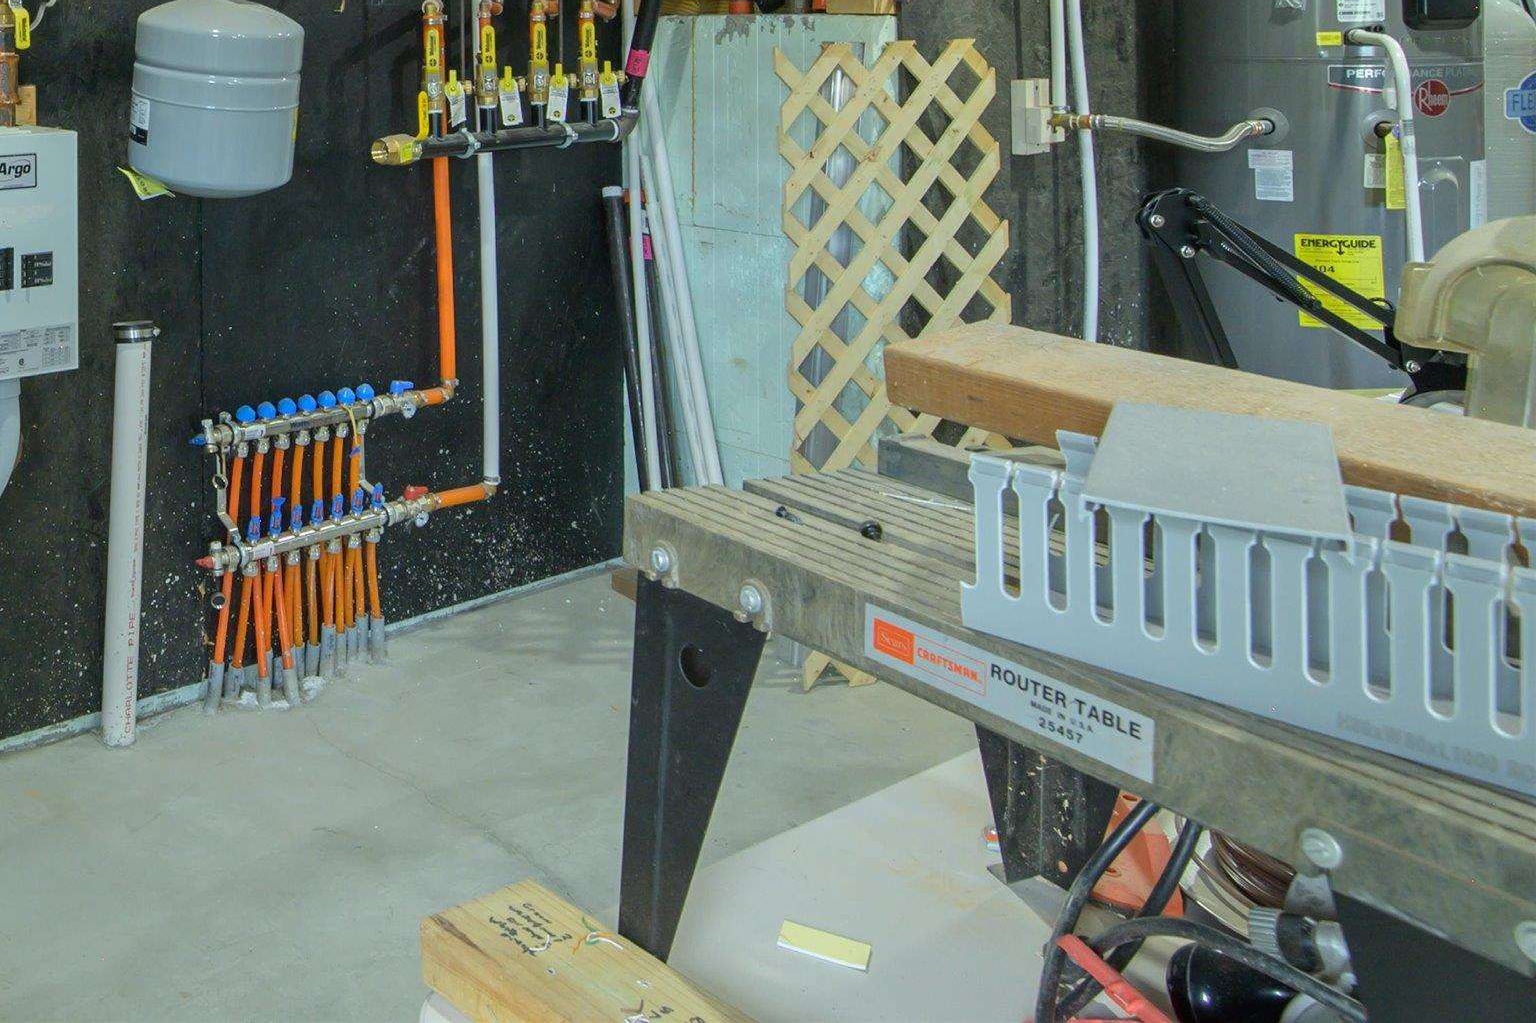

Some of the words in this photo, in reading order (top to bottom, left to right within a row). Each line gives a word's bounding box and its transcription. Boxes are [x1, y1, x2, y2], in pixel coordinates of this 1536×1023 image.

[1418, 80, 1448, 112] Rheem
[1300, 238, 1376, 250] ENERGYGUIDE
[128, 612, 136, 647] PIPE
[917, 647, 979, 683] CRAFTSMAN
[990, 663, 1068, 708] ROUTER
[1074, 697, 1142, 740] TABLE
[1030, 700, 1052, 716] MADE
[1038, 717, 1084, 744] 25457
